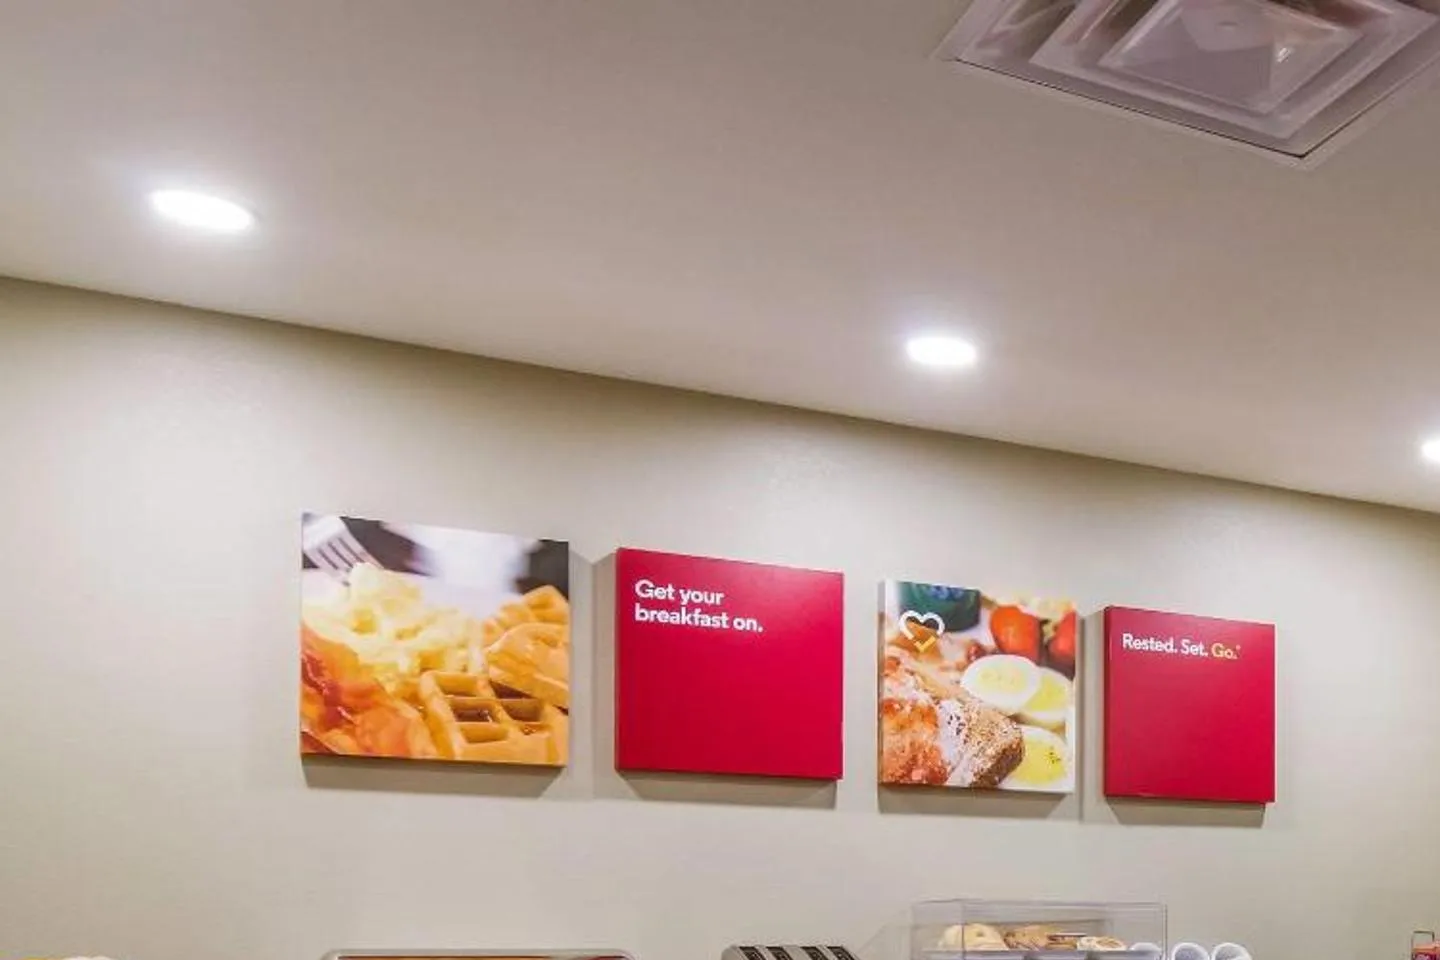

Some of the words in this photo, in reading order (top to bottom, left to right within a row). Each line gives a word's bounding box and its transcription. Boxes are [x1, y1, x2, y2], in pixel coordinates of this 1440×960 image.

[635, 579, 675, 600] Get
[679, 587, 724, 605] your
[635, 603, 730, 629] breakfast
[733, 616, 764, 632] on.
[1122, 633, 1178, 653] Rested.
[1181, 639, 1209, 657] Set.
